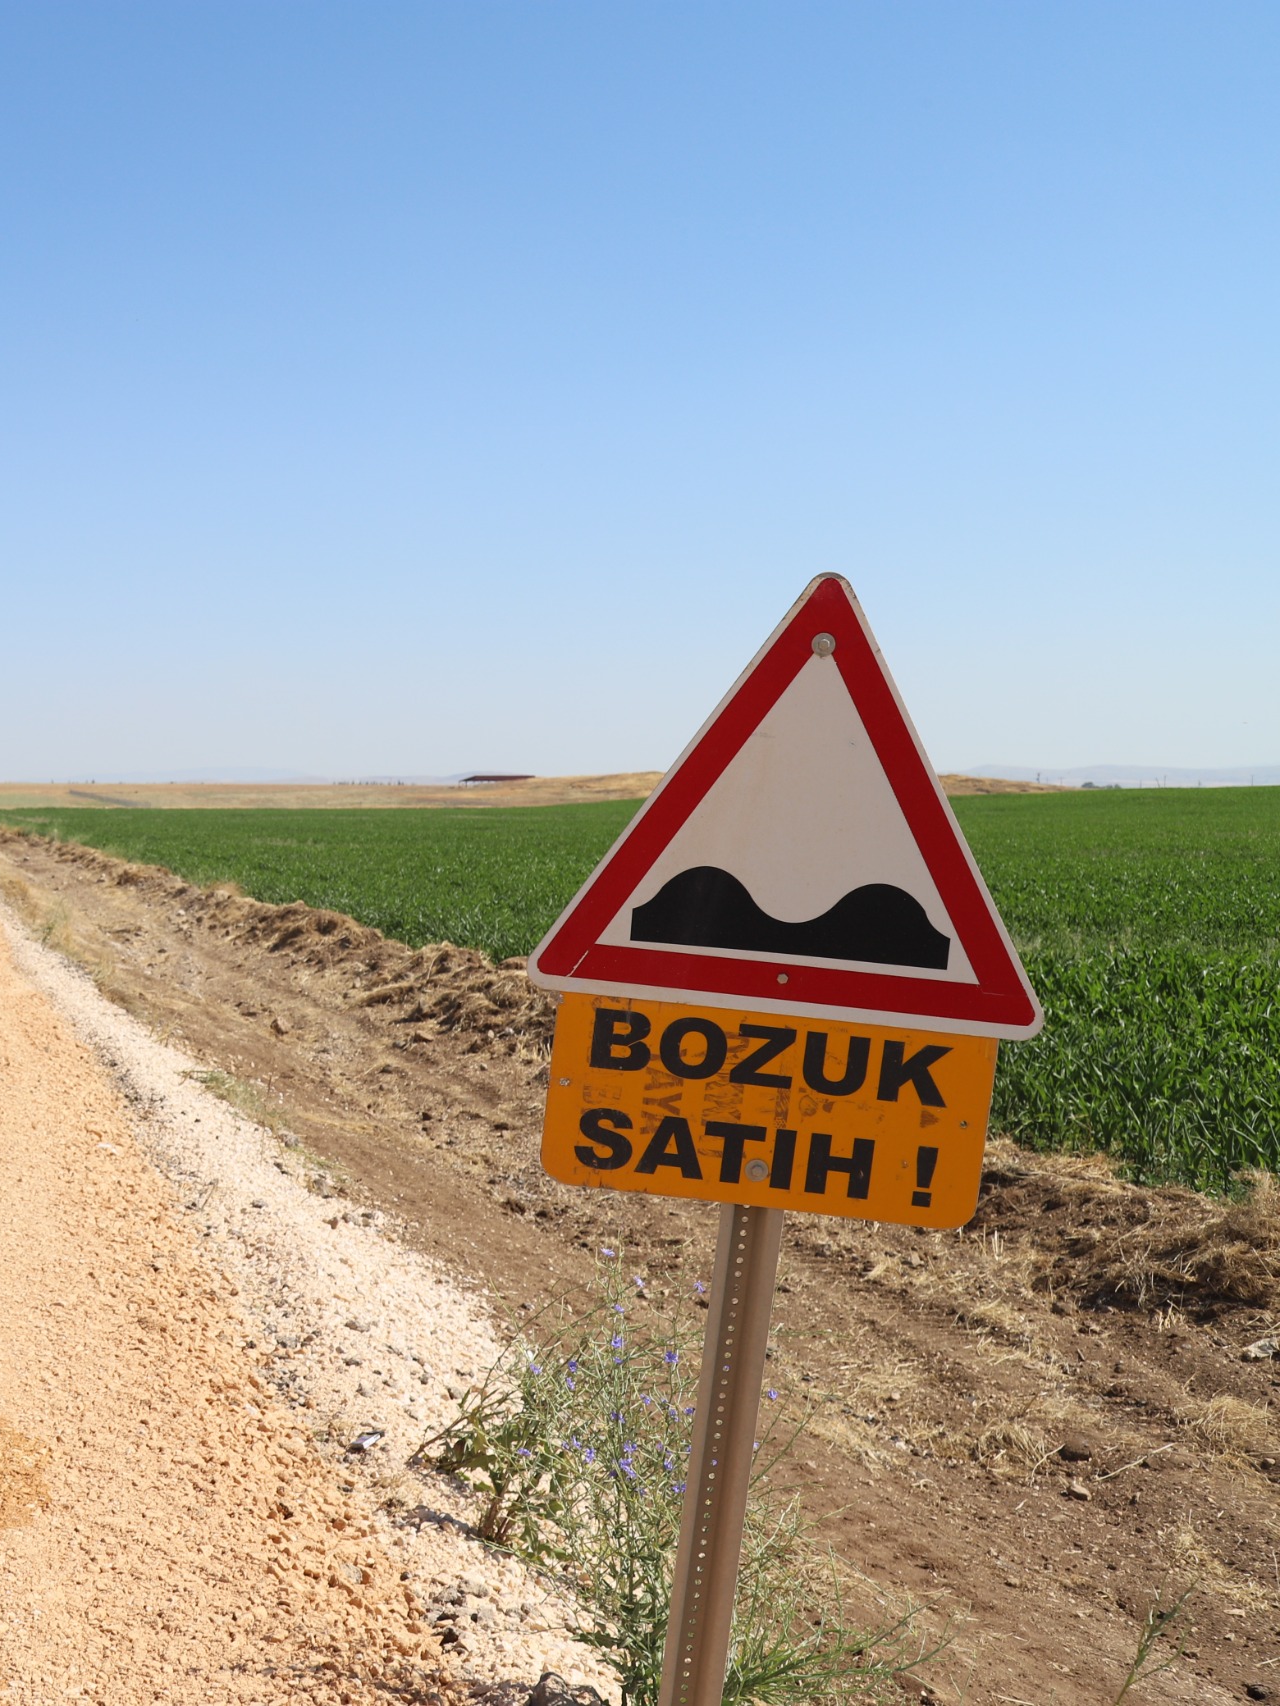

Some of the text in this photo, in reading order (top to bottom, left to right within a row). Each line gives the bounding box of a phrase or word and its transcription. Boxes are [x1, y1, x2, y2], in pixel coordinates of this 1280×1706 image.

[588, 1007, 953, 1108] BOZUK
[573, 1108, 939, 1208] SATIH !
